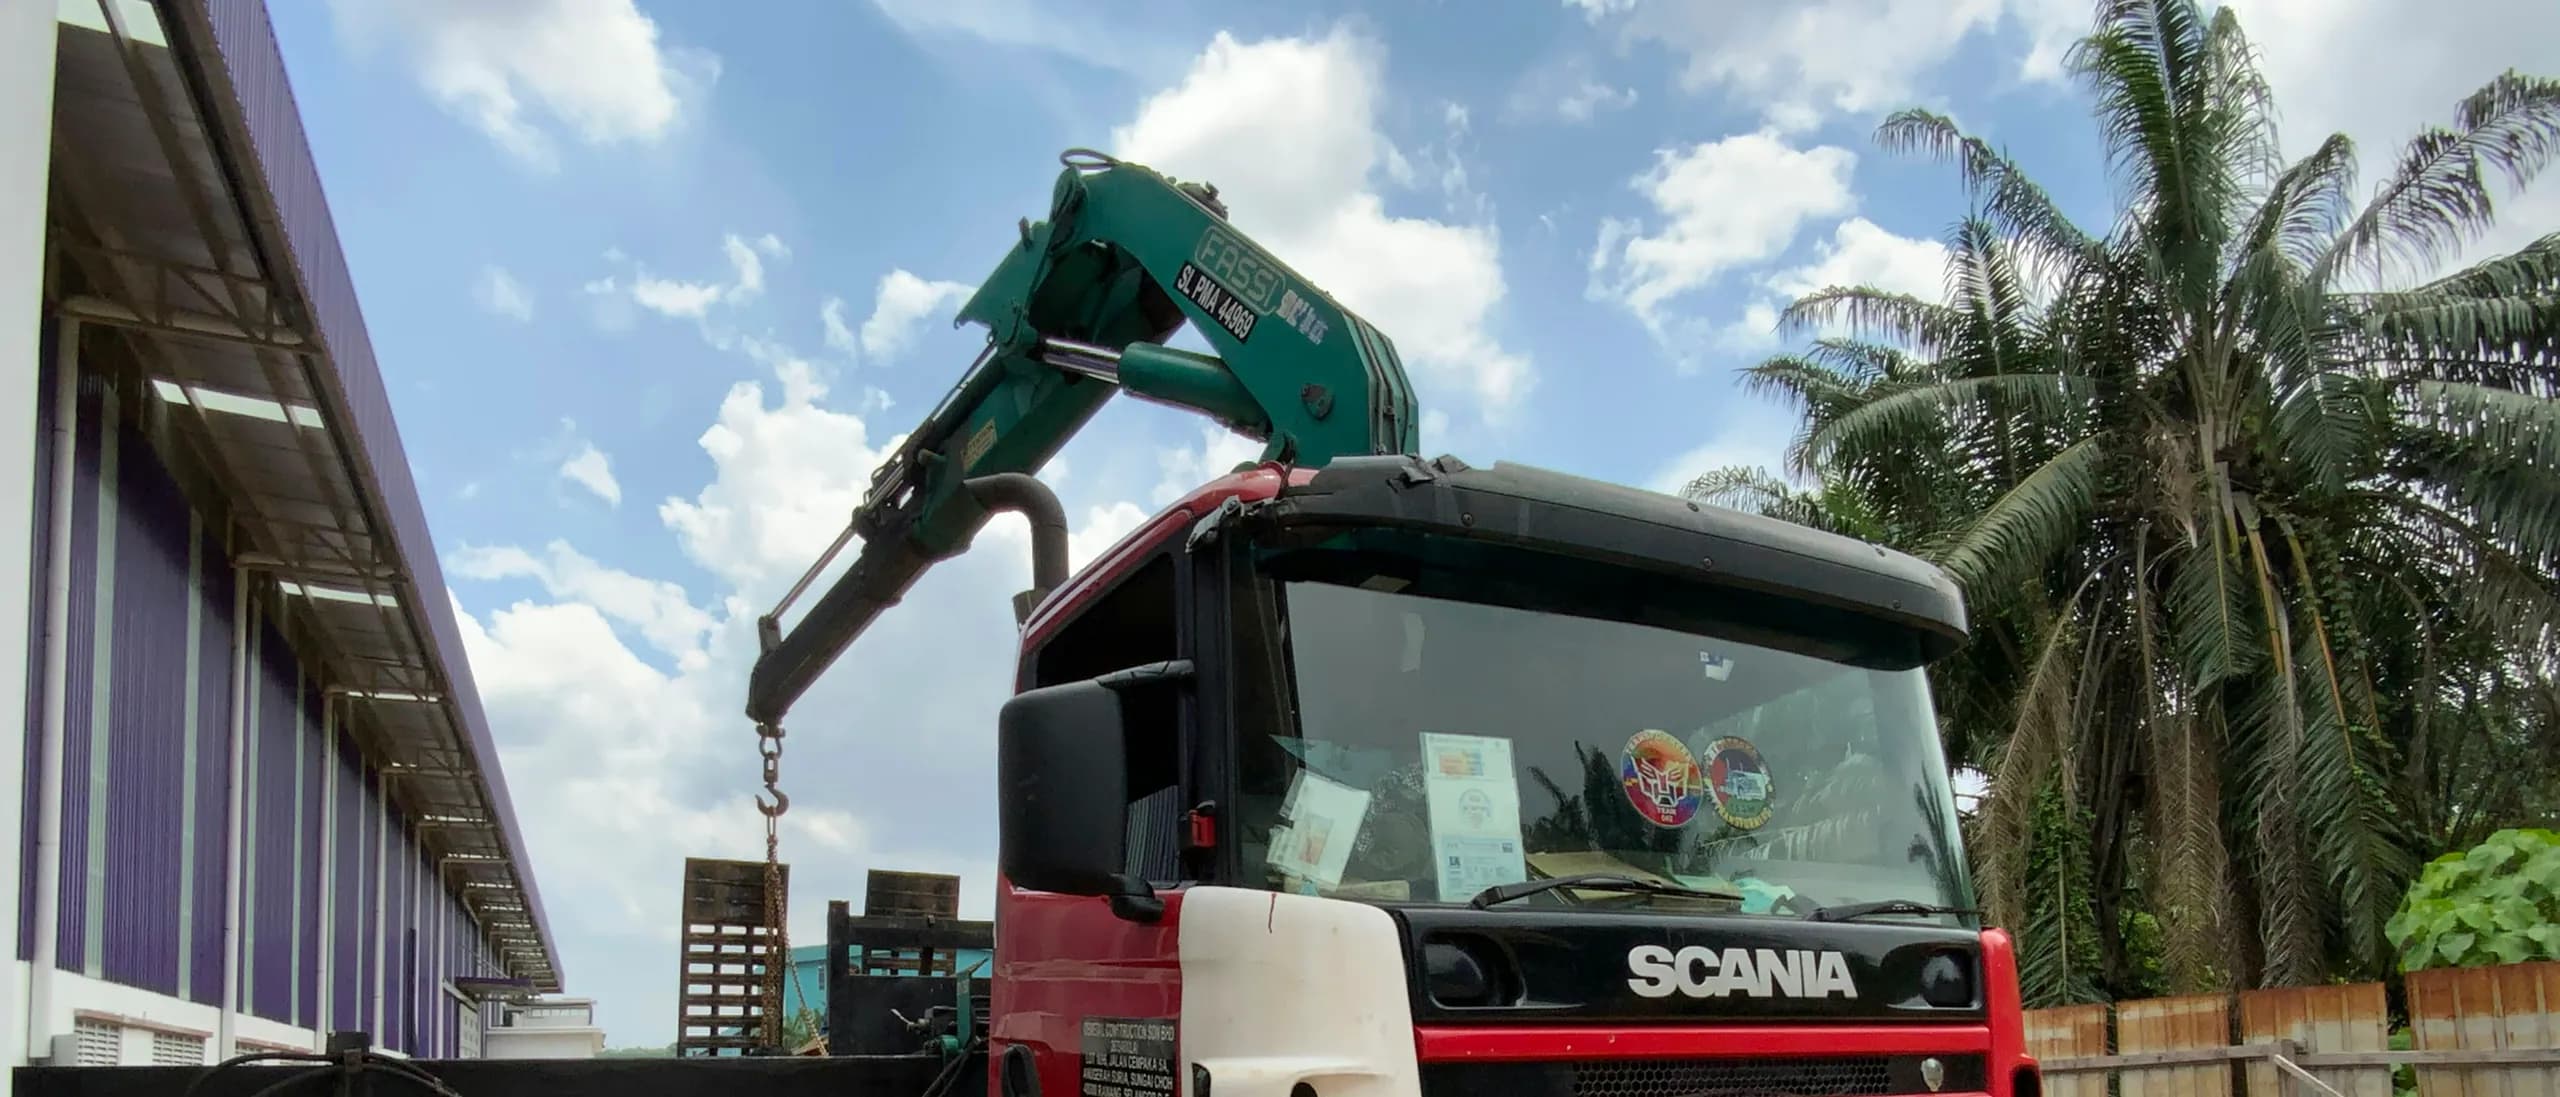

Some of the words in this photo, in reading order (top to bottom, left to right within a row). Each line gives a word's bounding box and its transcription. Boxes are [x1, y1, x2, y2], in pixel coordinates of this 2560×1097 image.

[1200, 231, 1280, 307] FASSI
[1177, 265, 1194, 294] SL
[1191, 275, 1220, 315] PMA
[1218, 297, 1254, 339] 44969
[1627, 945, 1859, 998] SCANIA
[1161, 1025, 1175, 1042] BHD
[1109, 1054, 1128, 1068] JALAN
[1128, 1055, 1157, 1071] CEMPAKA
[1130, 1071, 1154, 1089] SUNGAI
[1154, 1075, 1174, 1091] CHOH
